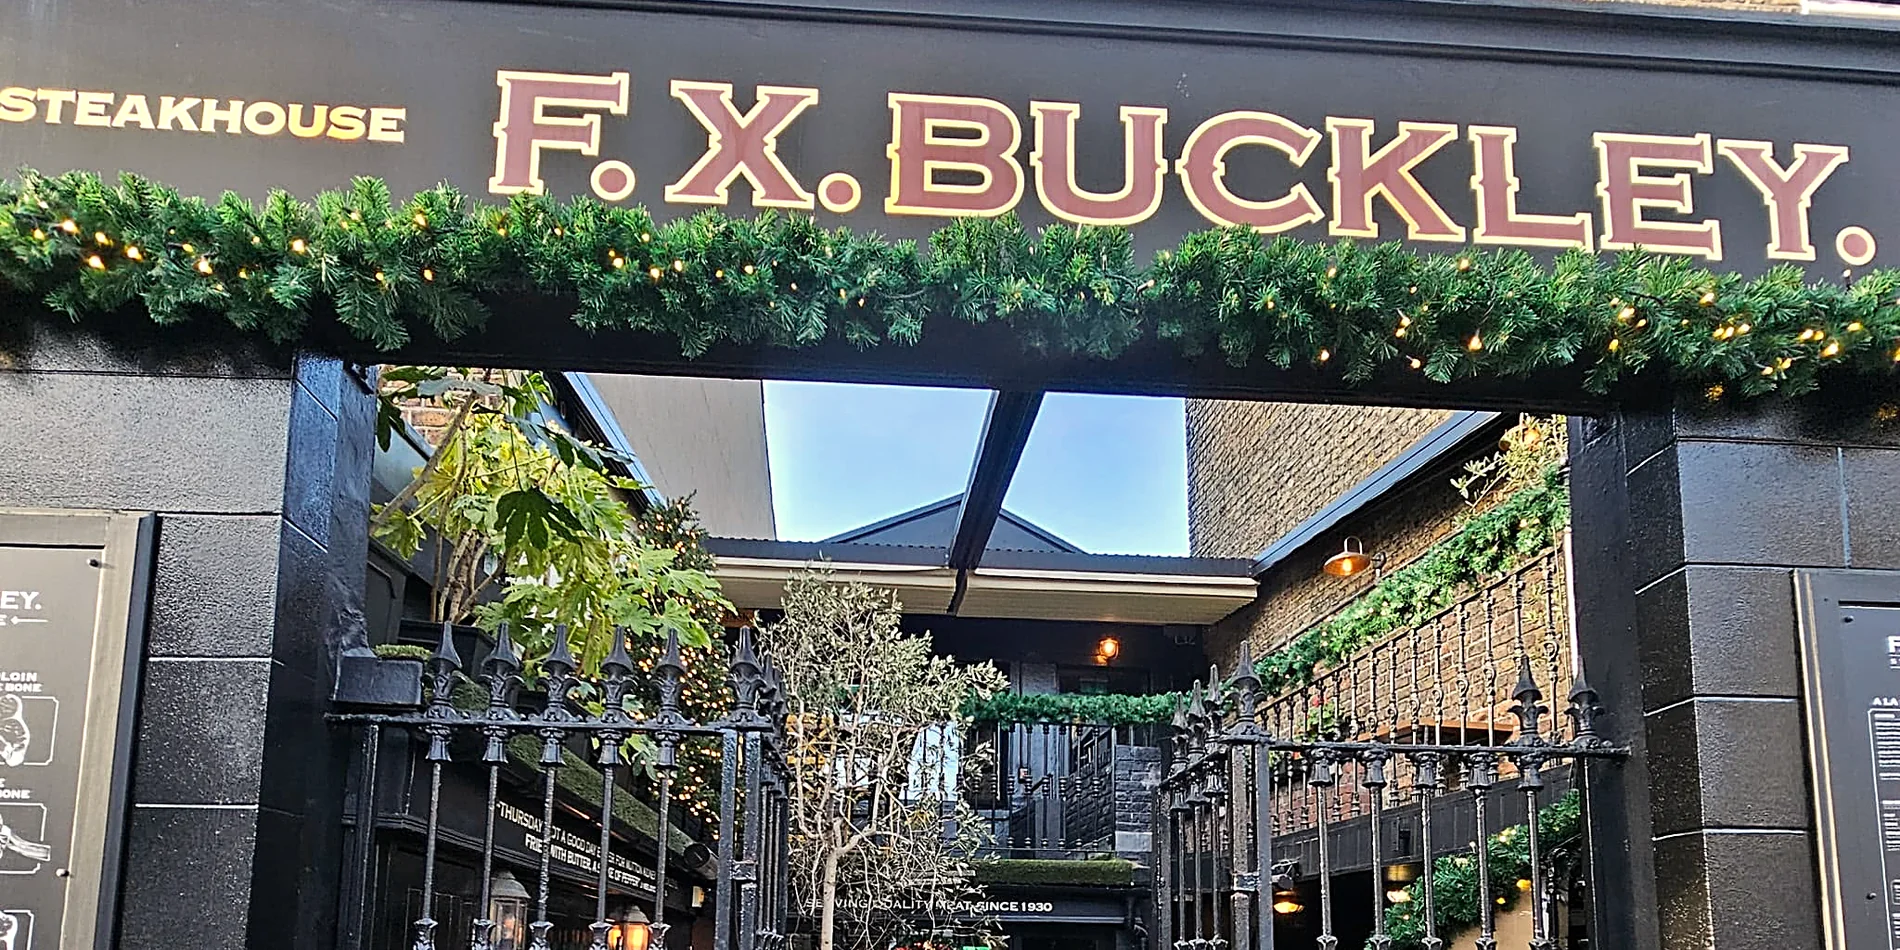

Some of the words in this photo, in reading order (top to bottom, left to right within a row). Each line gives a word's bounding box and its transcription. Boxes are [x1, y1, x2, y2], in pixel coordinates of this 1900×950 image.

[0, 87, 408, 143] STEAKHOUSE
[884, 92, 1877, 266] BUCKLEY.
[525, 832, 544, 854] FRIE
[976, 901, 1019, 912] SINCE
[1021, 901, 1053, 912] 1930
